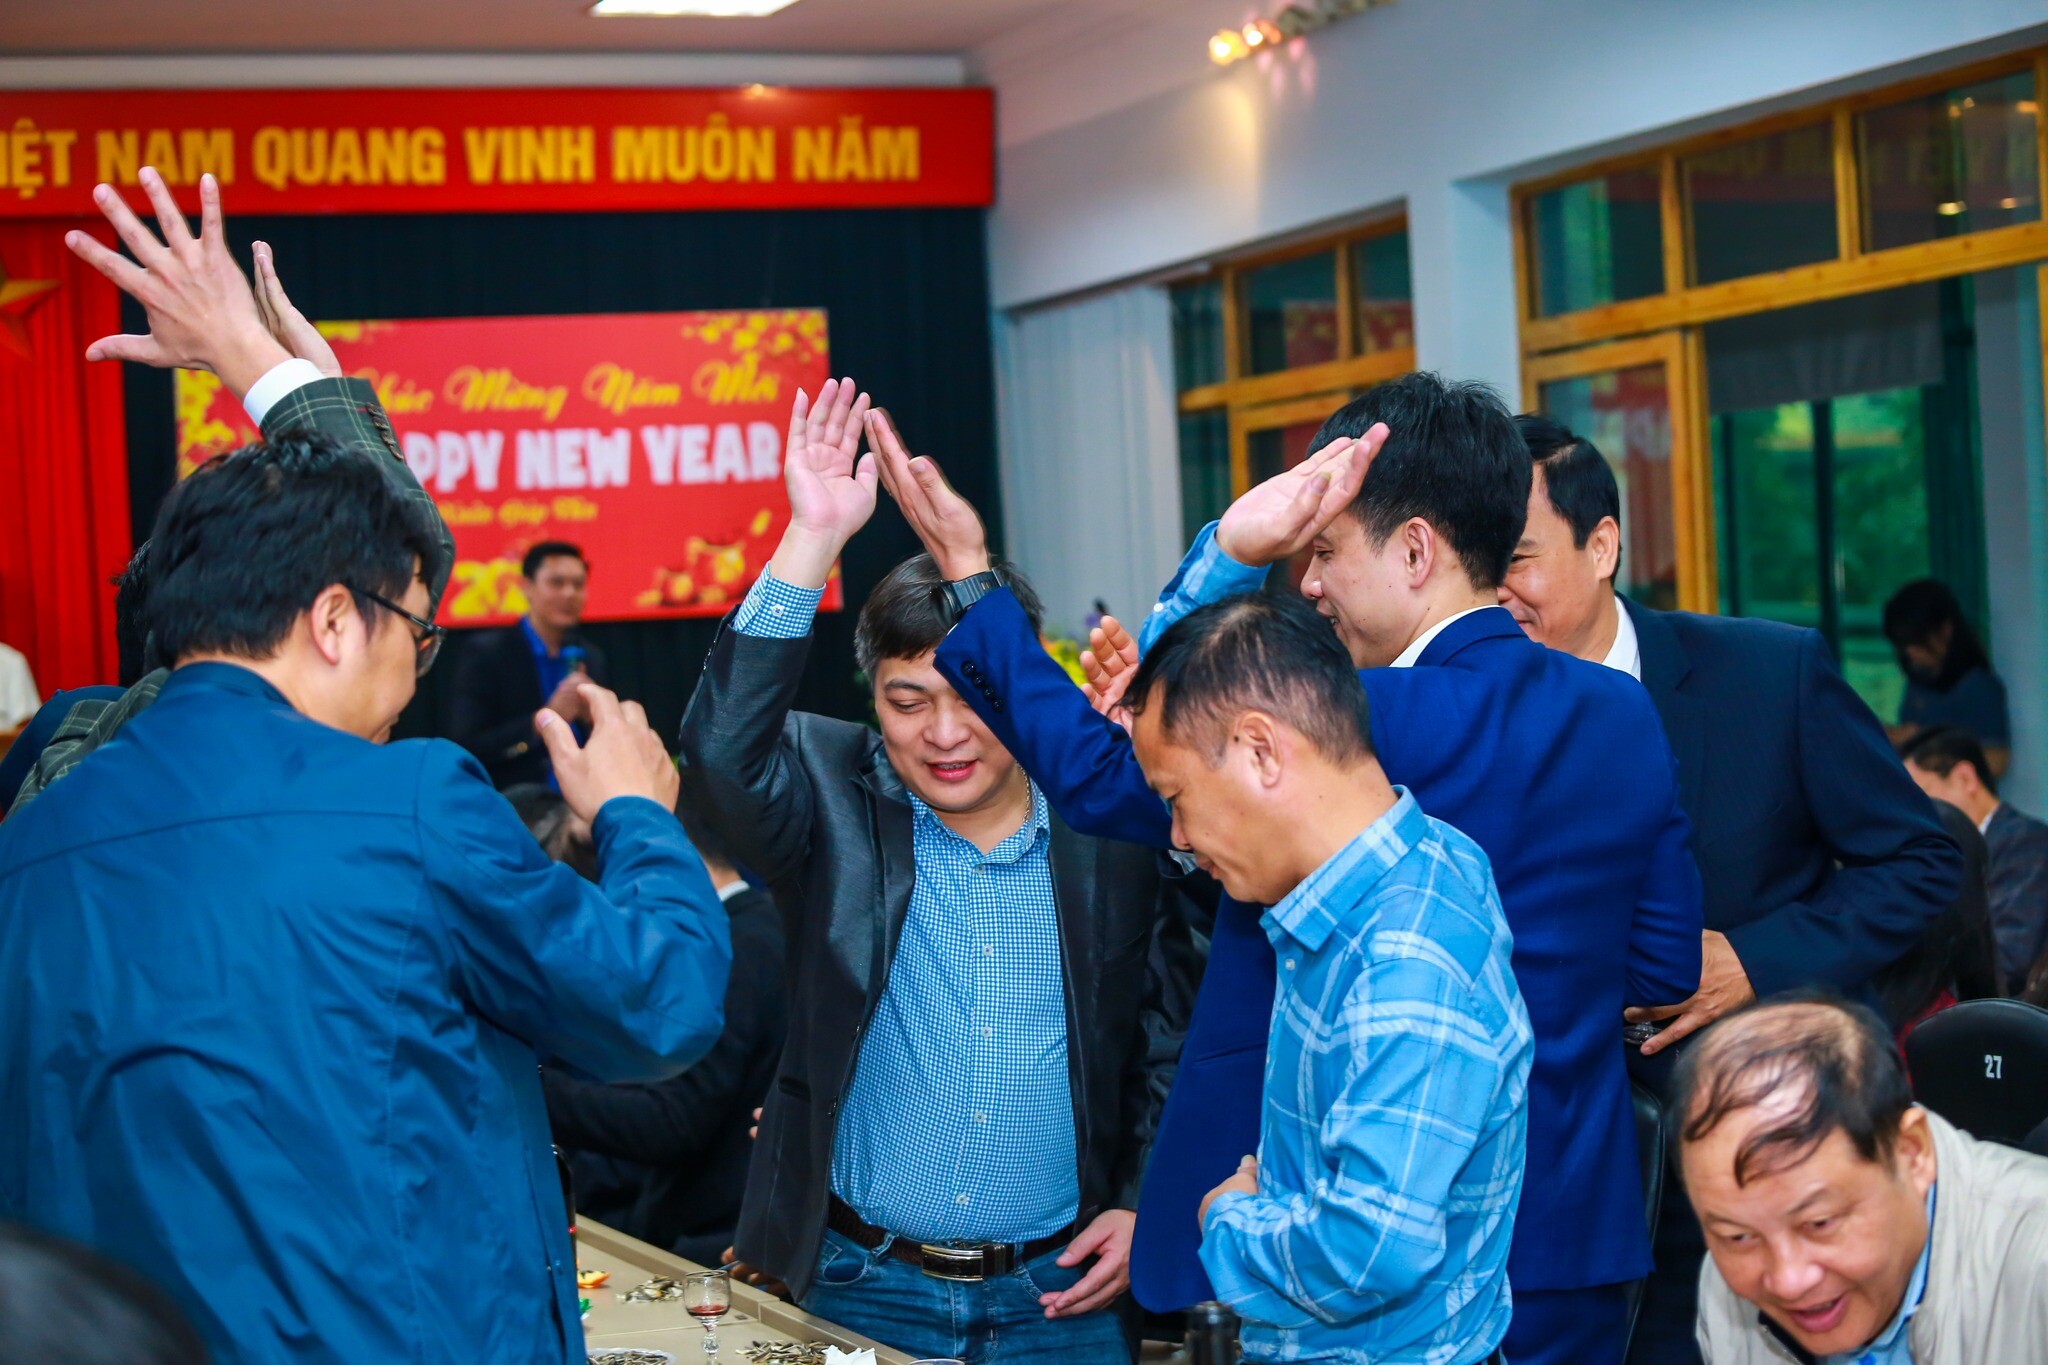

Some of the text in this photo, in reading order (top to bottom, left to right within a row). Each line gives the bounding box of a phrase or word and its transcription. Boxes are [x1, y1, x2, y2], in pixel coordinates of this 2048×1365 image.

[97, 129, 235, 186] NAM
[252, 126, 446, 190] QUANG
[464, 127, 595, 184] VINH
[612, 113, 776, 183] MUÔN
[793, 116, 920, 182] NĂM
[354, 352, 780, 422] húc Mừng Năm Mới
[403, 422, 781, 492] PPY NEW YEAR
[1984, 1054, 2003, 1079] 27
